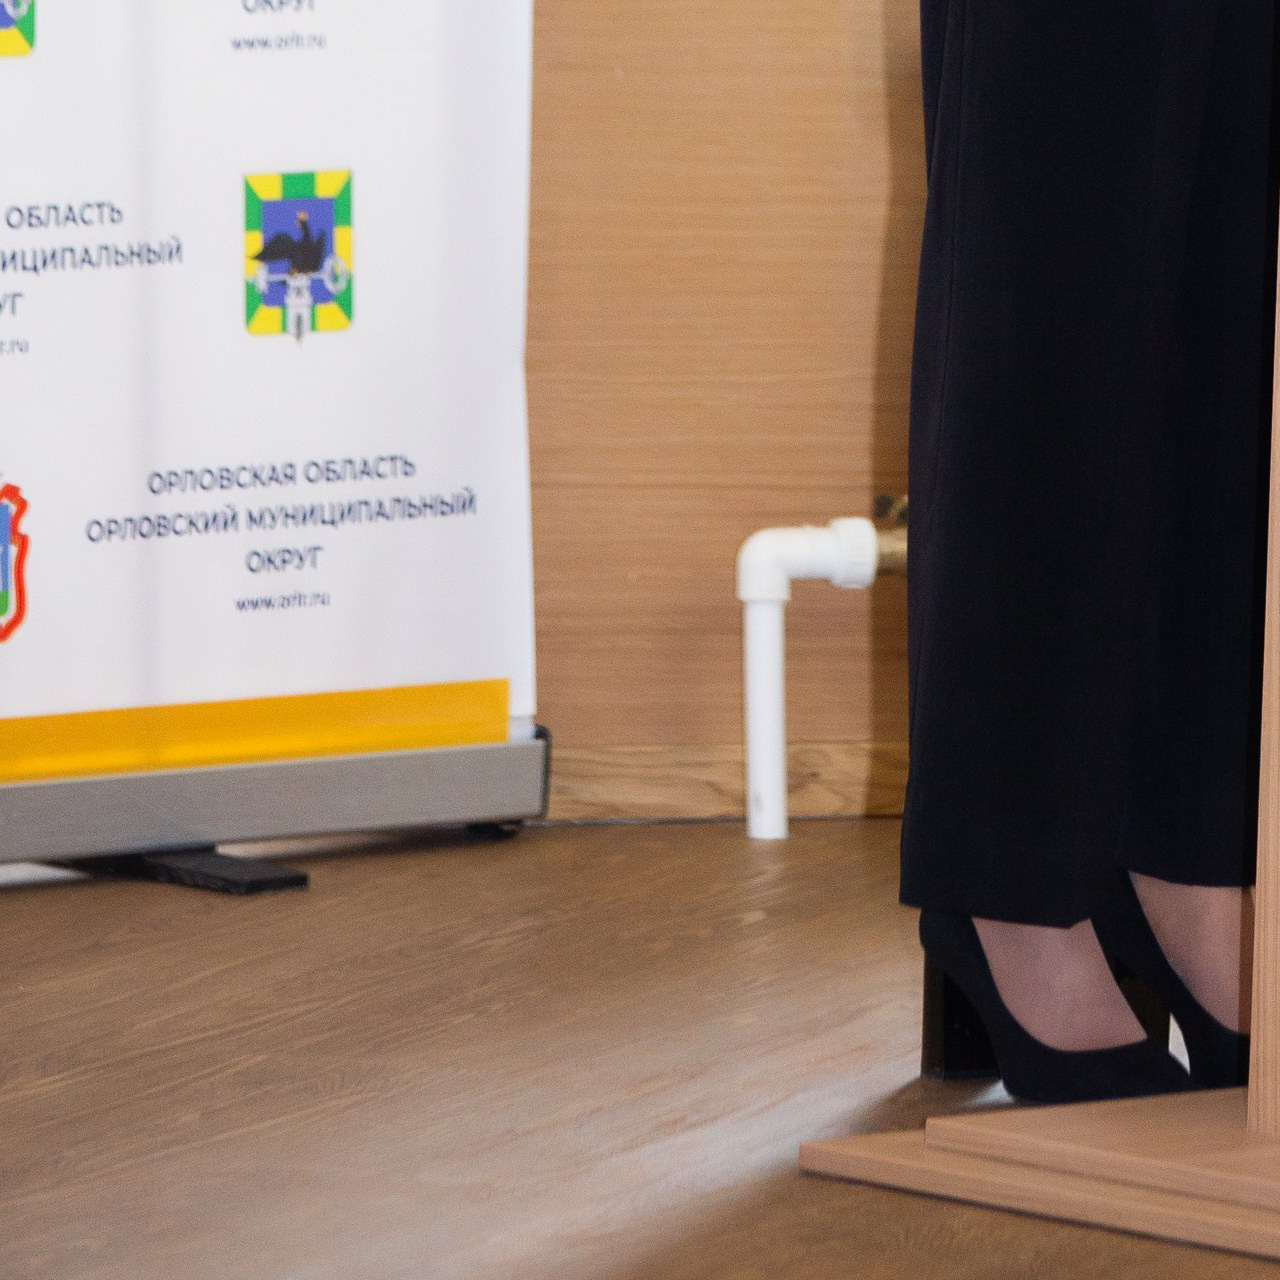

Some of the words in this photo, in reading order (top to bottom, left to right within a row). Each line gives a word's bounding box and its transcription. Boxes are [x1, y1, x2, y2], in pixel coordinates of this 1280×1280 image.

[4, 201, 123, 230] ОБЛАСТЬ
[146, 462, 297, 496] ОРЛОВСКАЯ
[303, 454, 416, 484] ОБЛАСТЬ
[85, 504, 239, 543] ОРЛОВСКИЙ
[246, 486, 477, 531] МУНИЦИПАЛЬНЫЙ
[245, 545, 324, 574] ОКРУГ
